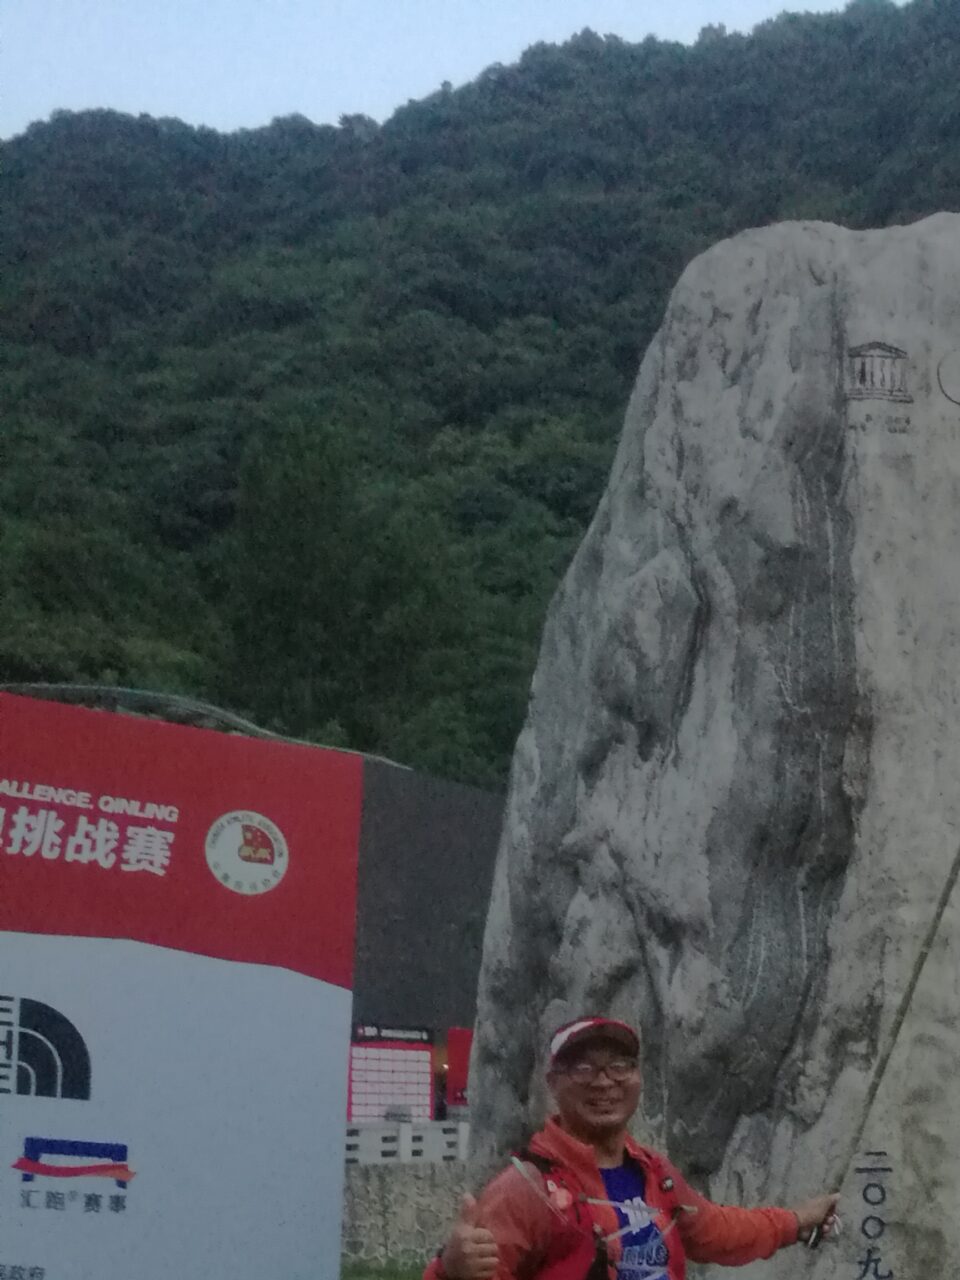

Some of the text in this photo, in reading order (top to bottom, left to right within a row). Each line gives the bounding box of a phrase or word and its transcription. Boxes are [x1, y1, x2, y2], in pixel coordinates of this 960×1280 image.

[98, 795, 179, 823] QINLING
[0, 806, 175, 876] 挑战赛
